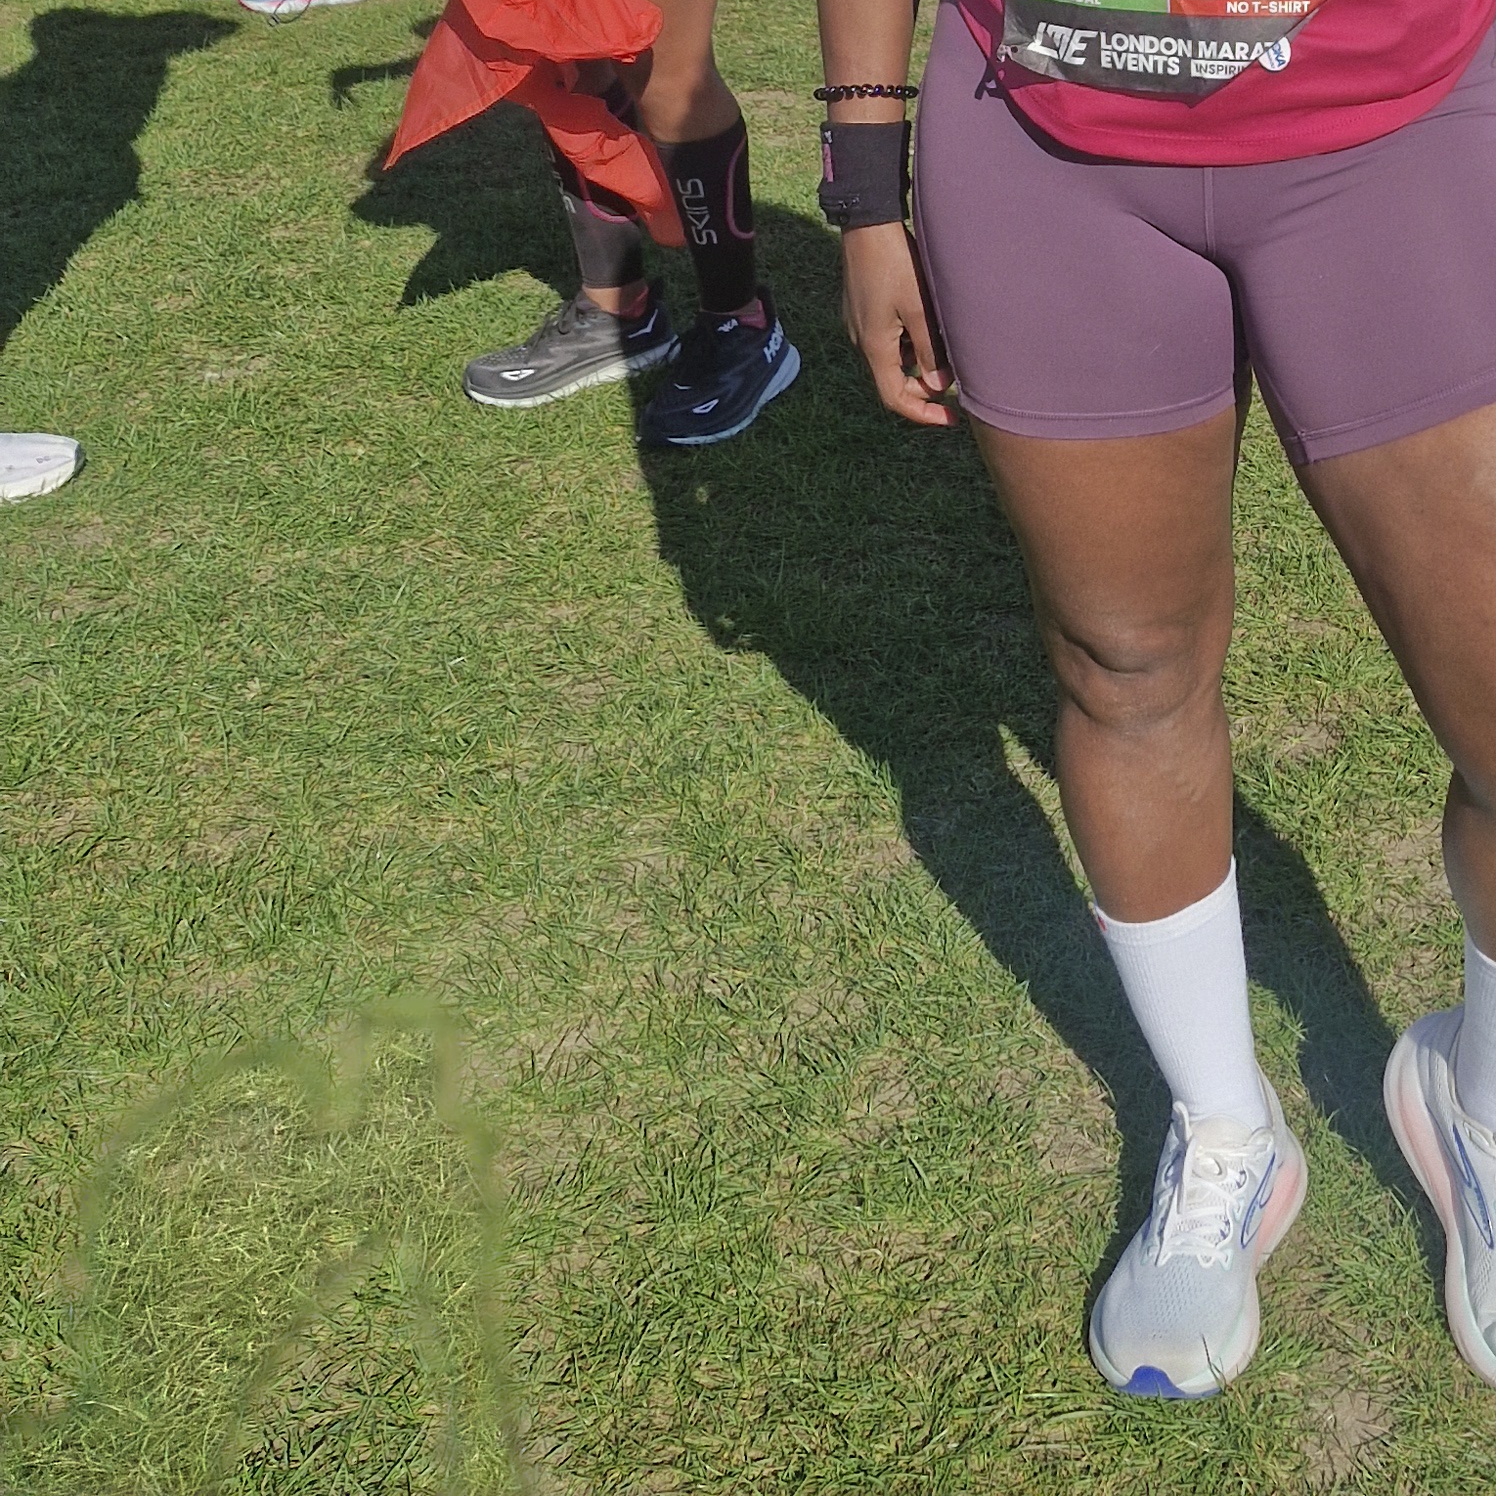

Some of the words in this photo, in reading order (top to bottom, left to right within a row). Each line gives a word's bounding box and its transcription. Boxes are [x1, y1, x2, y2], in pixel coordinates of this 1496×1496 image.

[1226, 0, 1249, 14] NO
[1252, 0, 1311, 15] T-SHIRT
[1100, 30, 1193, 58] LONDON
[1100, 51, 1180, 76] EVENTS
[676, 177, 718, 246] SKINS
